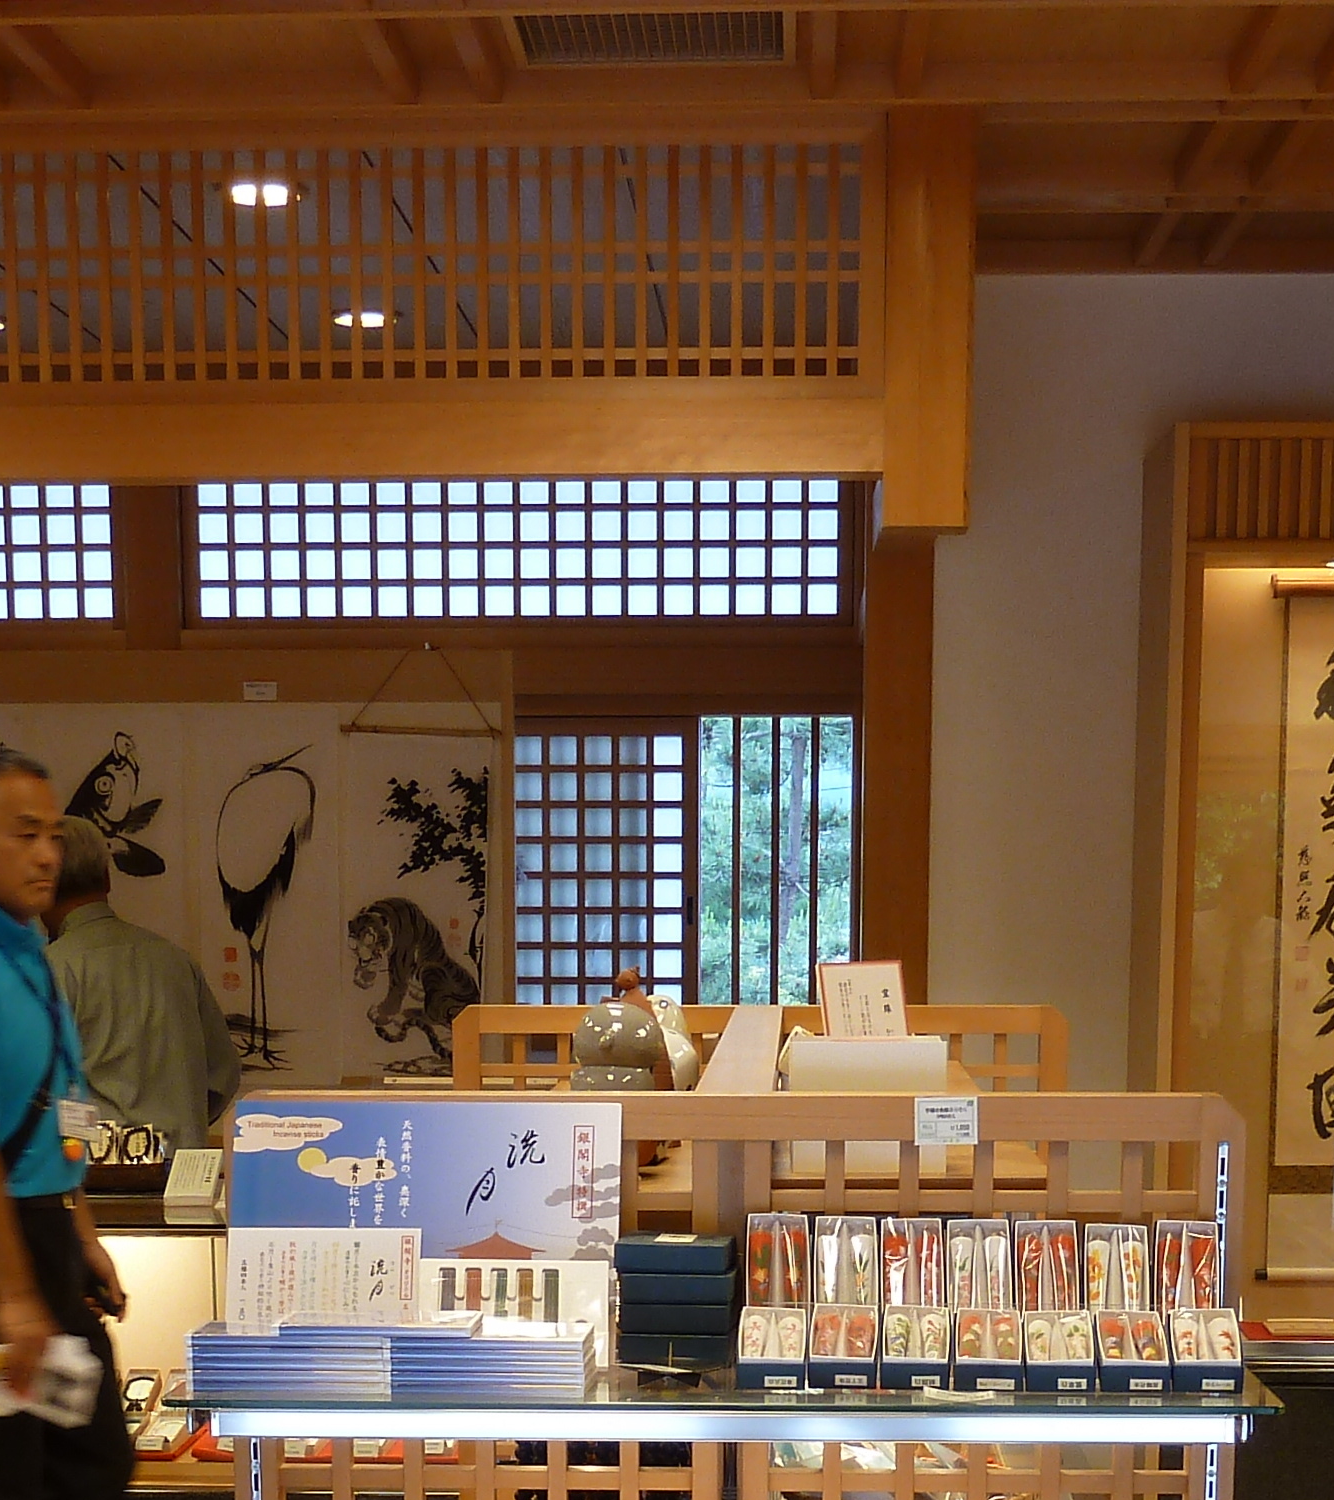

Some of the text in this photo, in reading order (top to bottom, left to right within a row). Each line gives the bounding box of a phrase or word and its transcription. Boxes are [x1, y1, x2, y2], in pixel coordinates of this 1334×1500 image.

[248, 1121, 322, 1129] Traditional Japanese
[273, 1130, 302, 1138] Incense
